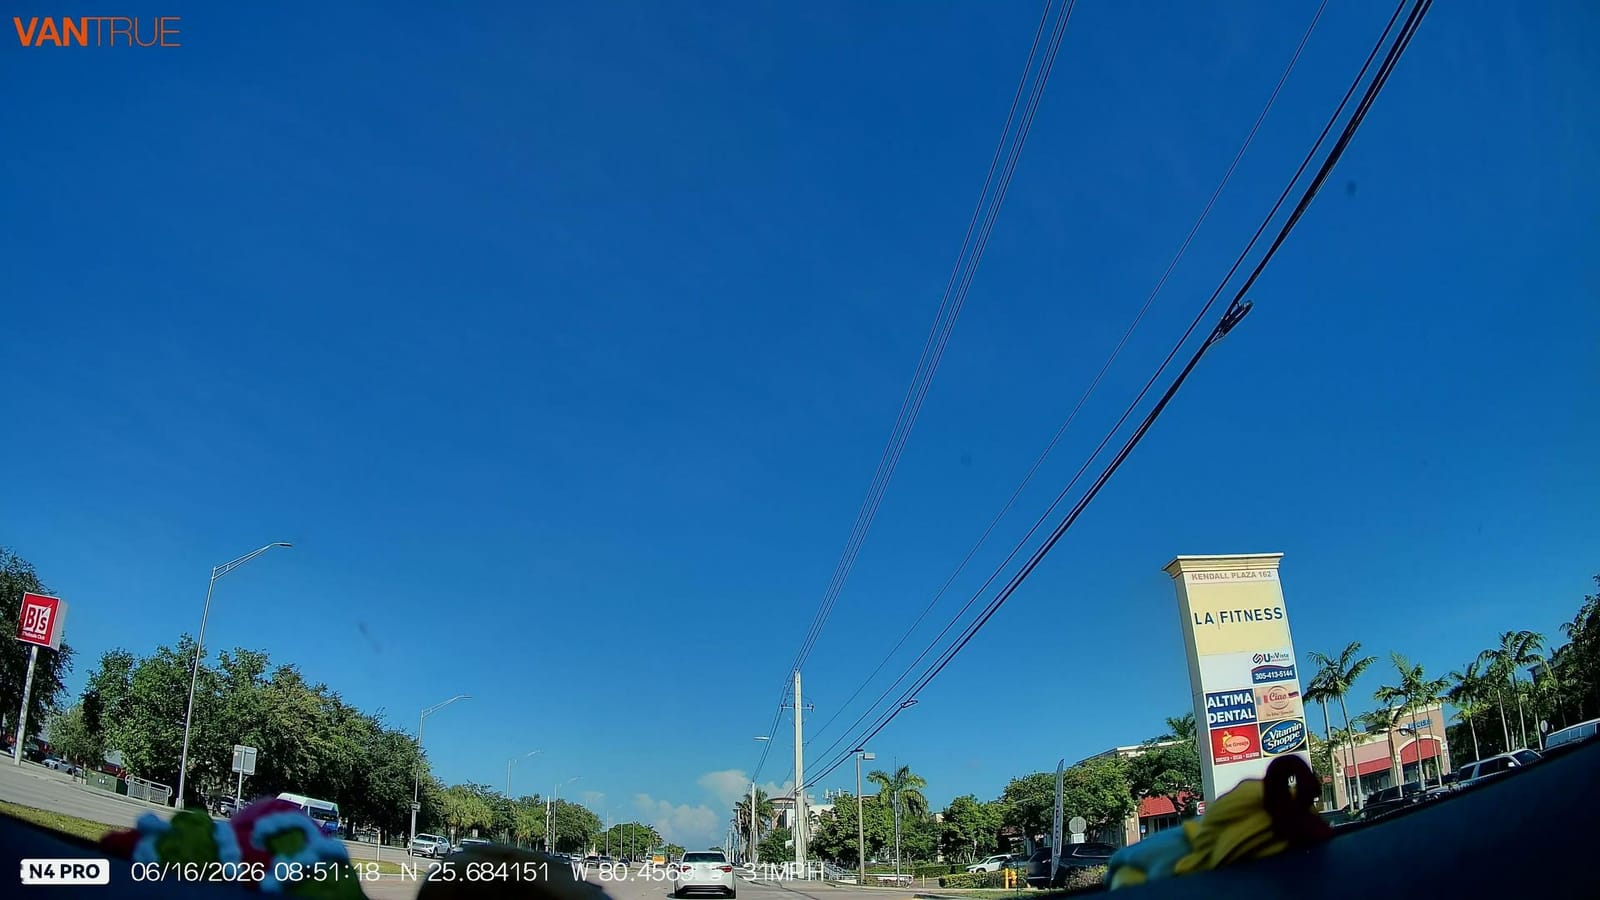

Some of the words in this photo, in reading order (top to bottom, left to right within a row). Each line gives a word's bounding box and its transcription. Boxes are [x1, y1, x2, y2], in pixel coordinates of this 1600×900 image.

[1191, 572, 1230, 581] KENDALL
[1231, 571, 1257, 579] PLAZA
[1258, 570, 1273, 578] 162
[1194, 612, 1215, 625] LA
[1220, 607, 1283, 624] FITNESS
[1255, 669, 1293, 680] 305-413-5144
[1207, 692, 1253, 708] ALTIMA
[1269, 690, 1287, 701] Ciao
[1208, 708, 1256, 724] DENTAL
[1269, 723, 1302, 740] Vitamin
[1267, 731, 1301, 750] Shoppe
